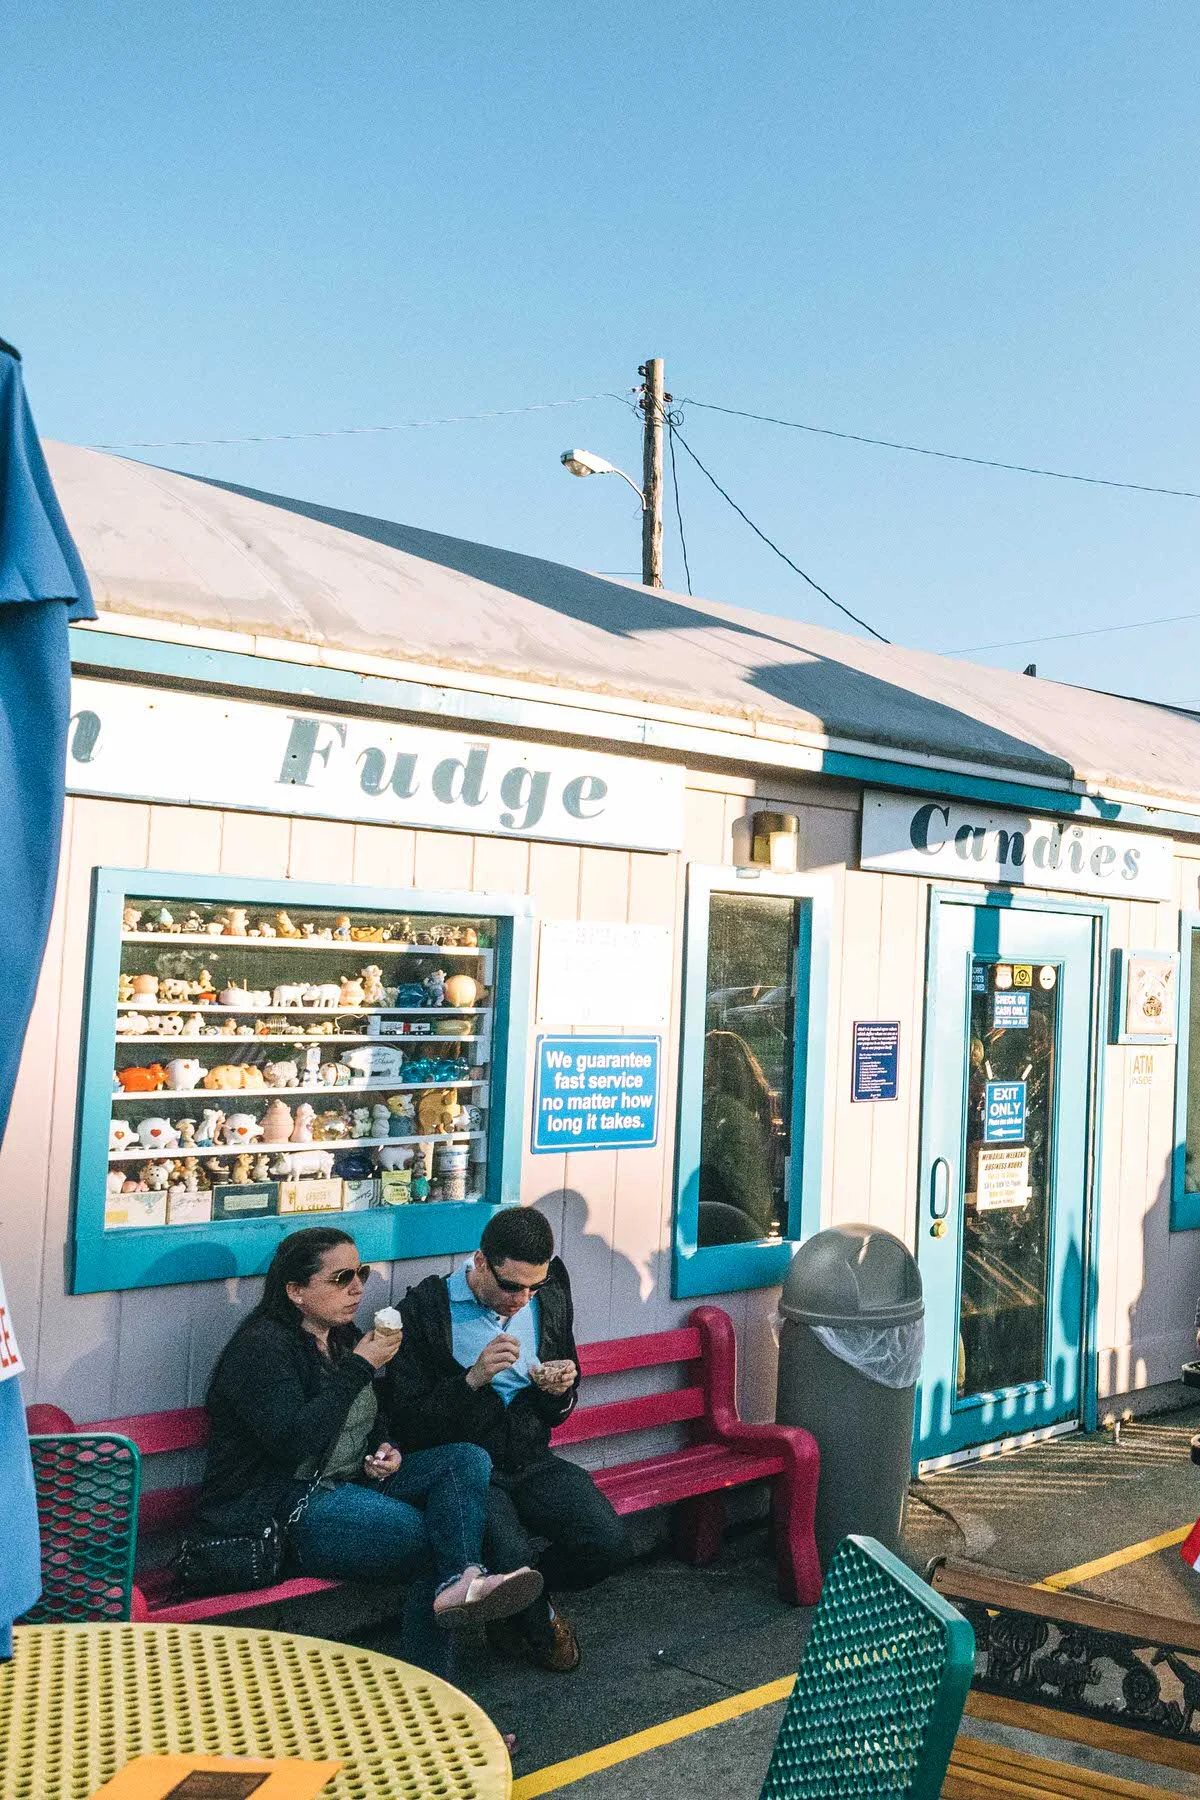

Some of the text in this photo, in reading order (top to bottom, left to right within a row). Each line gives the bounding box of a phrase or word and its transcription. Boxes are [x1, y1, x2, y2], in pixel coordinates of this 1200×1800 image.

[274, 715, 609, 830] Fudge
[909, 803, 1141, 881] Candies
[1012, 1006, 1028, 1016] ONLY
[546, 1051, 652, 1073] We guarantee
[1133, 1055, 1154, 1075] ATM
[554, 1071, 643, 1089] fast service
[542, 1091, 653, 1110] no matter how
[994, 1087, 1019, 1101] EXIT
[990, 1102, 1021, 1116] ONLY
[547, 1112, 645, 1135] long it takes.
[1005, 1151, 1027, 1159] WEEKEND
[984, 1161, 1023, 1171] BUSINESS HOURS
